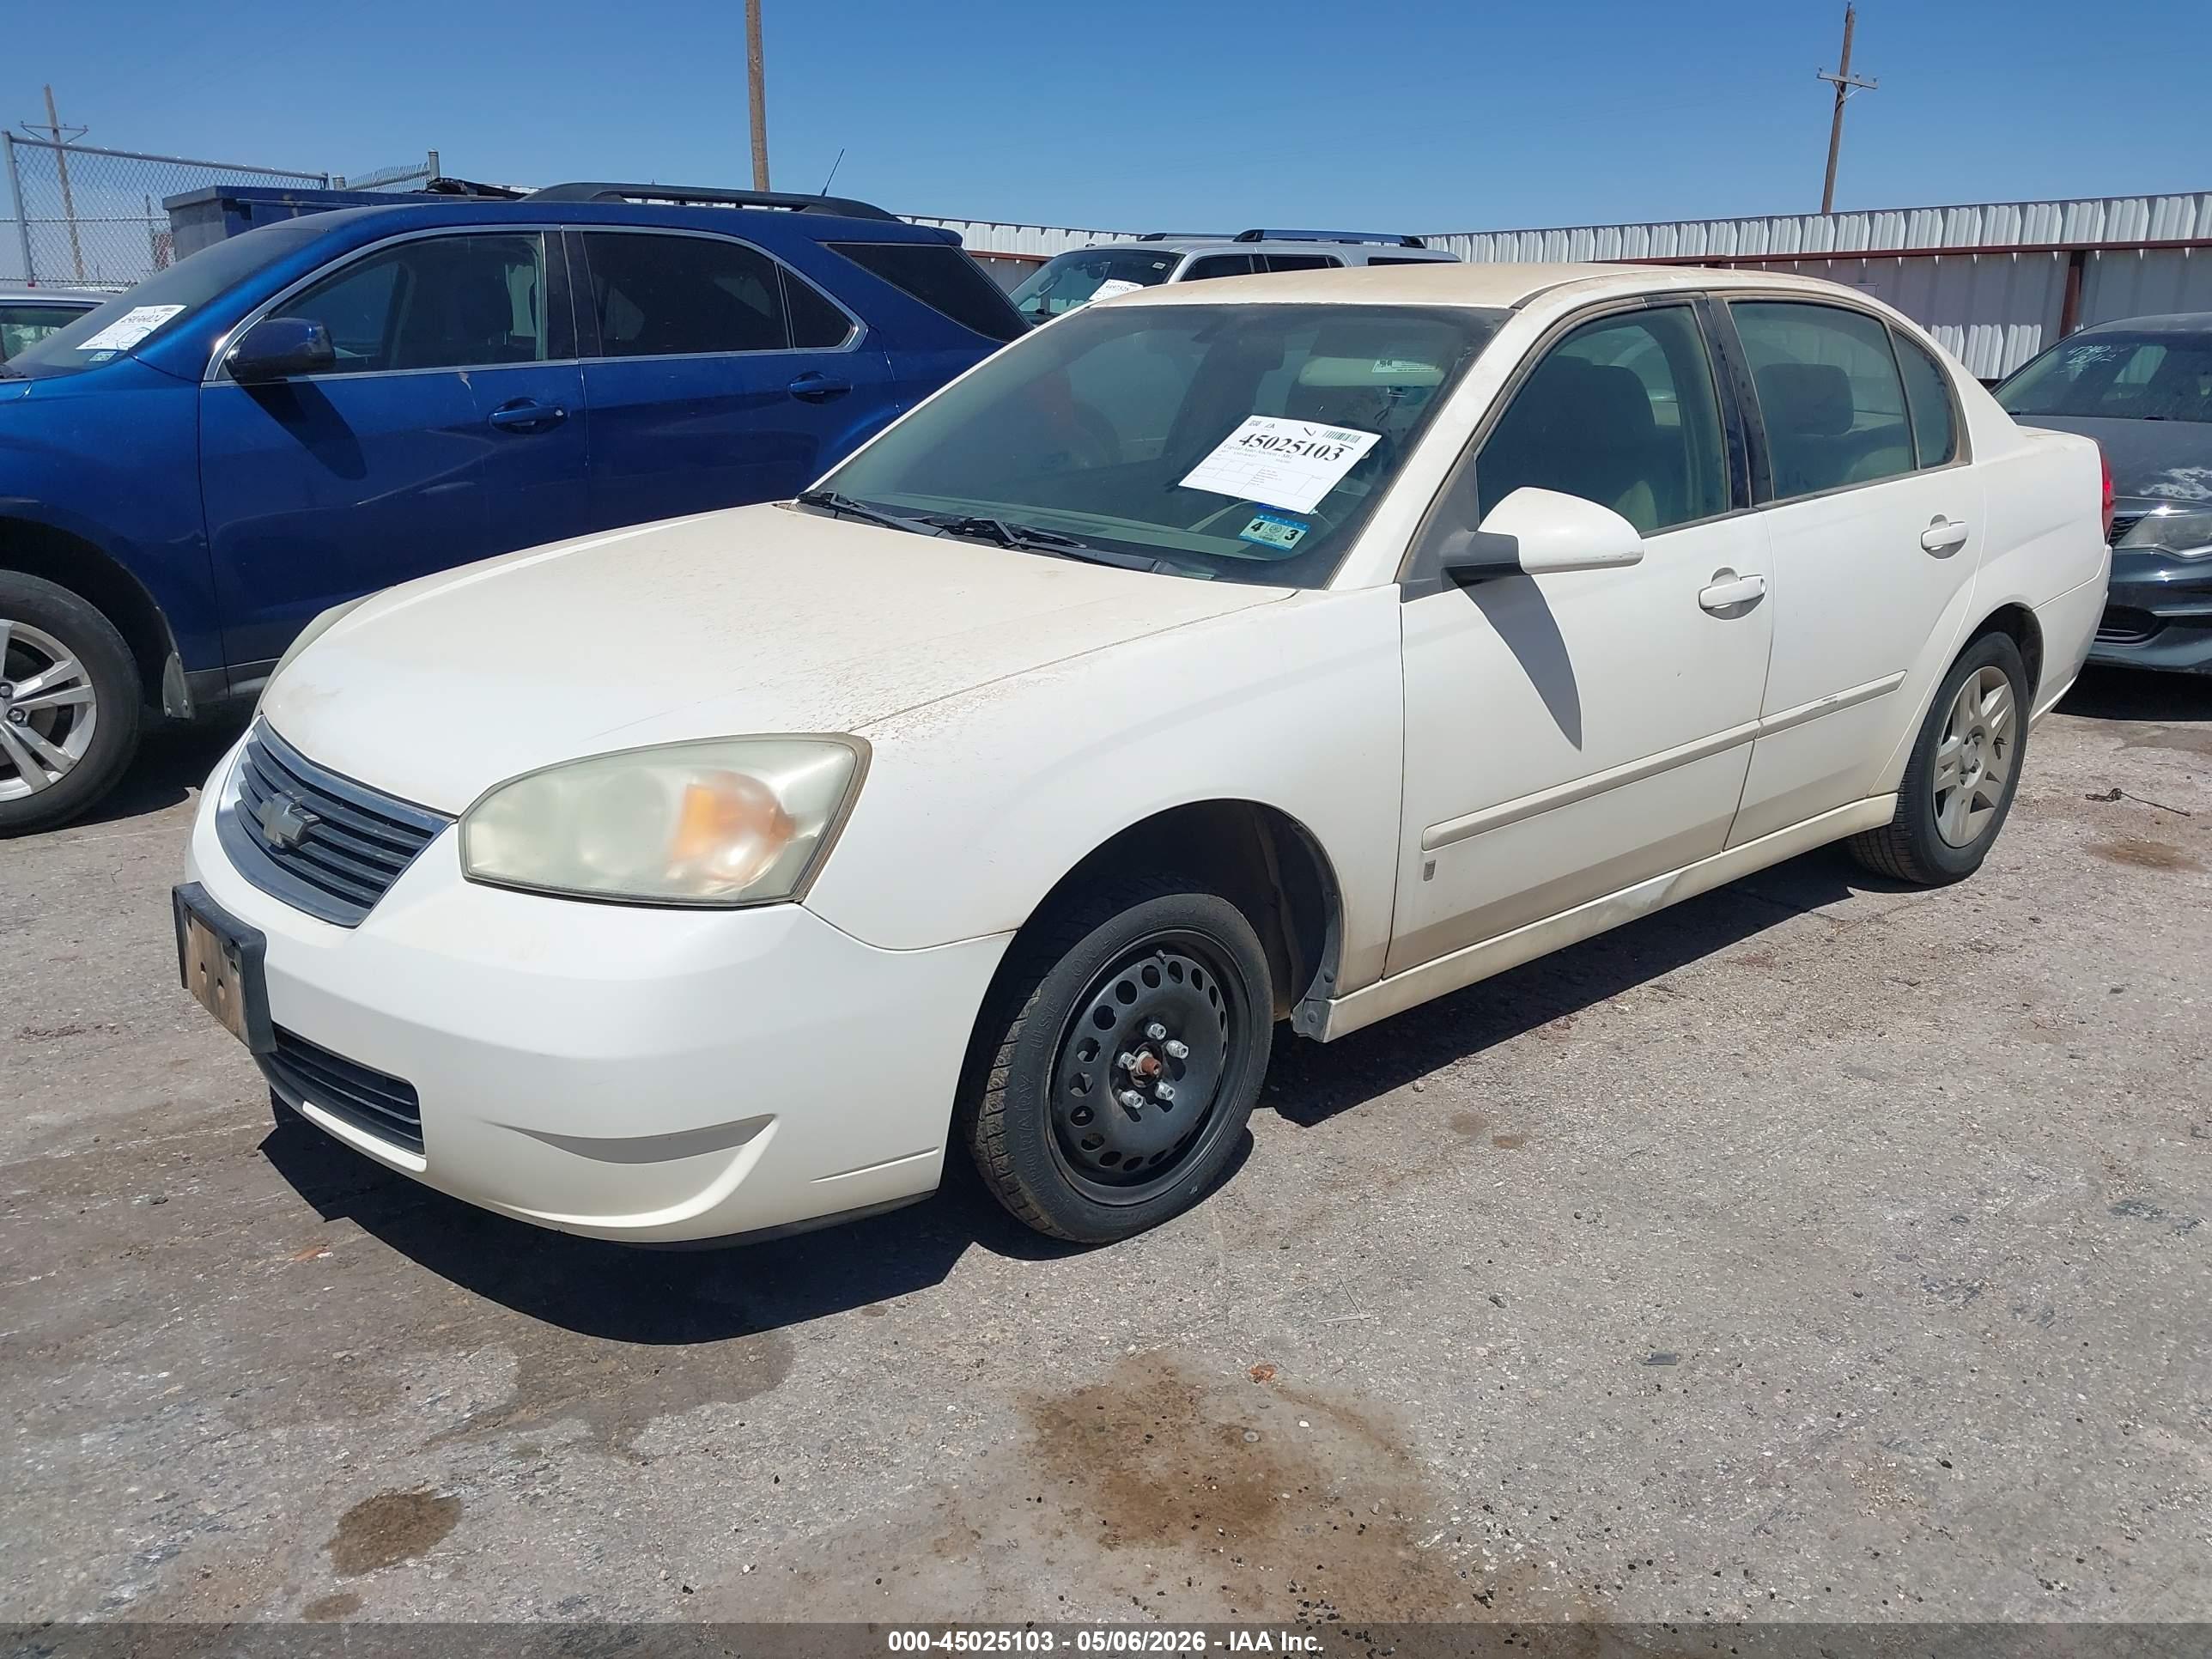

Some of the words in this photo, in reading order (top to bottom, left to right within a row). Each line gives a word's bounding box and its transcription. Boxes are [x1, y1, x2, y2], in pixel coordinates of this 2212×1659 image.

[1238, 433, 1345, 462] 45025103
[1250, 521, 1266, 532] 4
[1284, 529, 1299, 541] 3
[1030, 994, 1060, 1049] USE
[1072, 919, 1121, 977] ONLY
